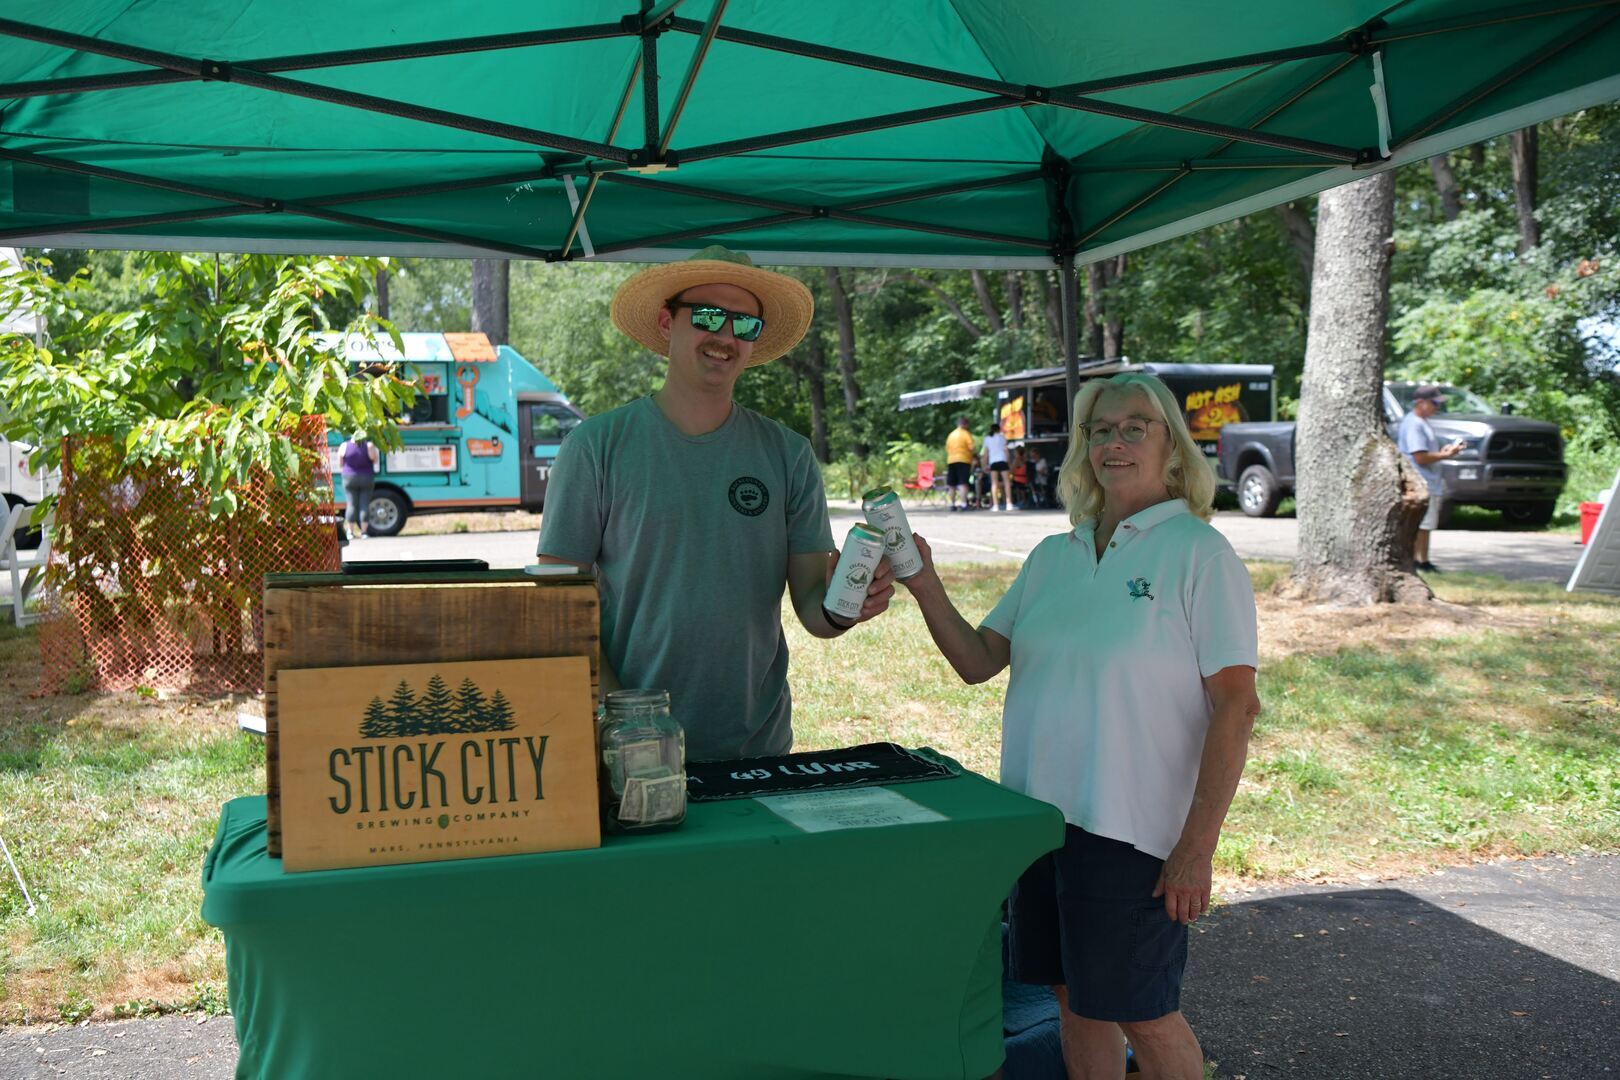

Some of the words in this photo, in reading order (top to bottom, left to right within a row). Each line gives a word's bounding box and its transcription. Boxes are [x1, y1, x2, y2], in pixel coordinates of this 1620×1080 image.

[350, 340, 397, 352] OM'S
[1186, 390, 1213, 411] HOT
[1214, 382, 1241, 404] ASH
[328, 741, 449, 814] STICK
[460, 735, 550, 805] CITY
[778, 761, 881, 776] LUKR
[357, 817, 433, 829] BREWING
[453, 809, 531, 823] COMPANY
[419, 836, 519, 850] PENNSYLVANIA
